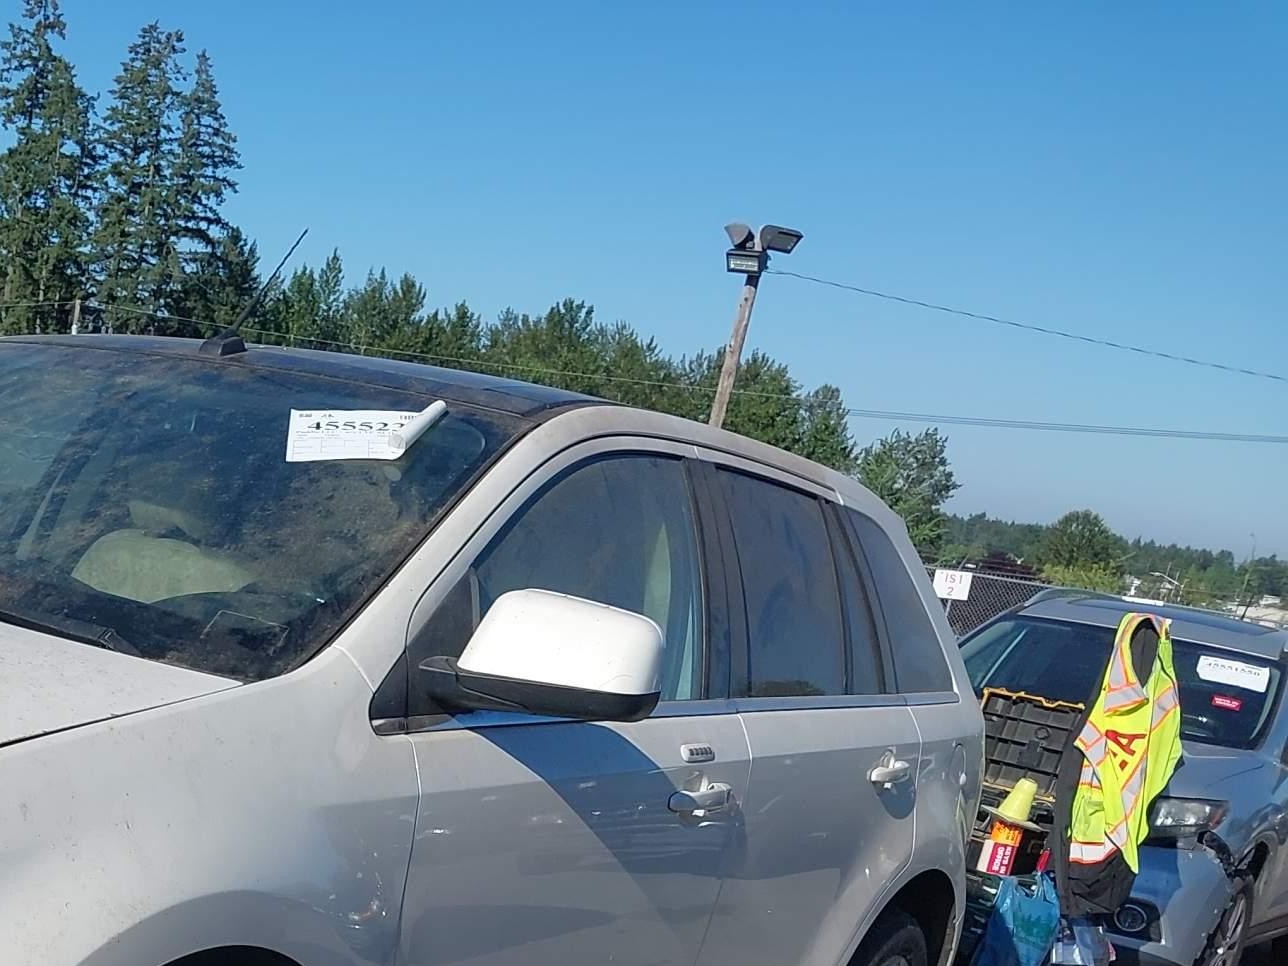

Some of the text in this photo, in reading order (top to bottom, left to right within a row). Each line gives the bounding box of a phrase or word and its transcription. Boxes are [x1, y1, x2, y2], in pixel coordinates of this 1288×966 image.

[946, 586, 954, 597] 2
[992, 846, 1005, 872] OFFICE
[1002, 846, 1012, 865] KEYS
